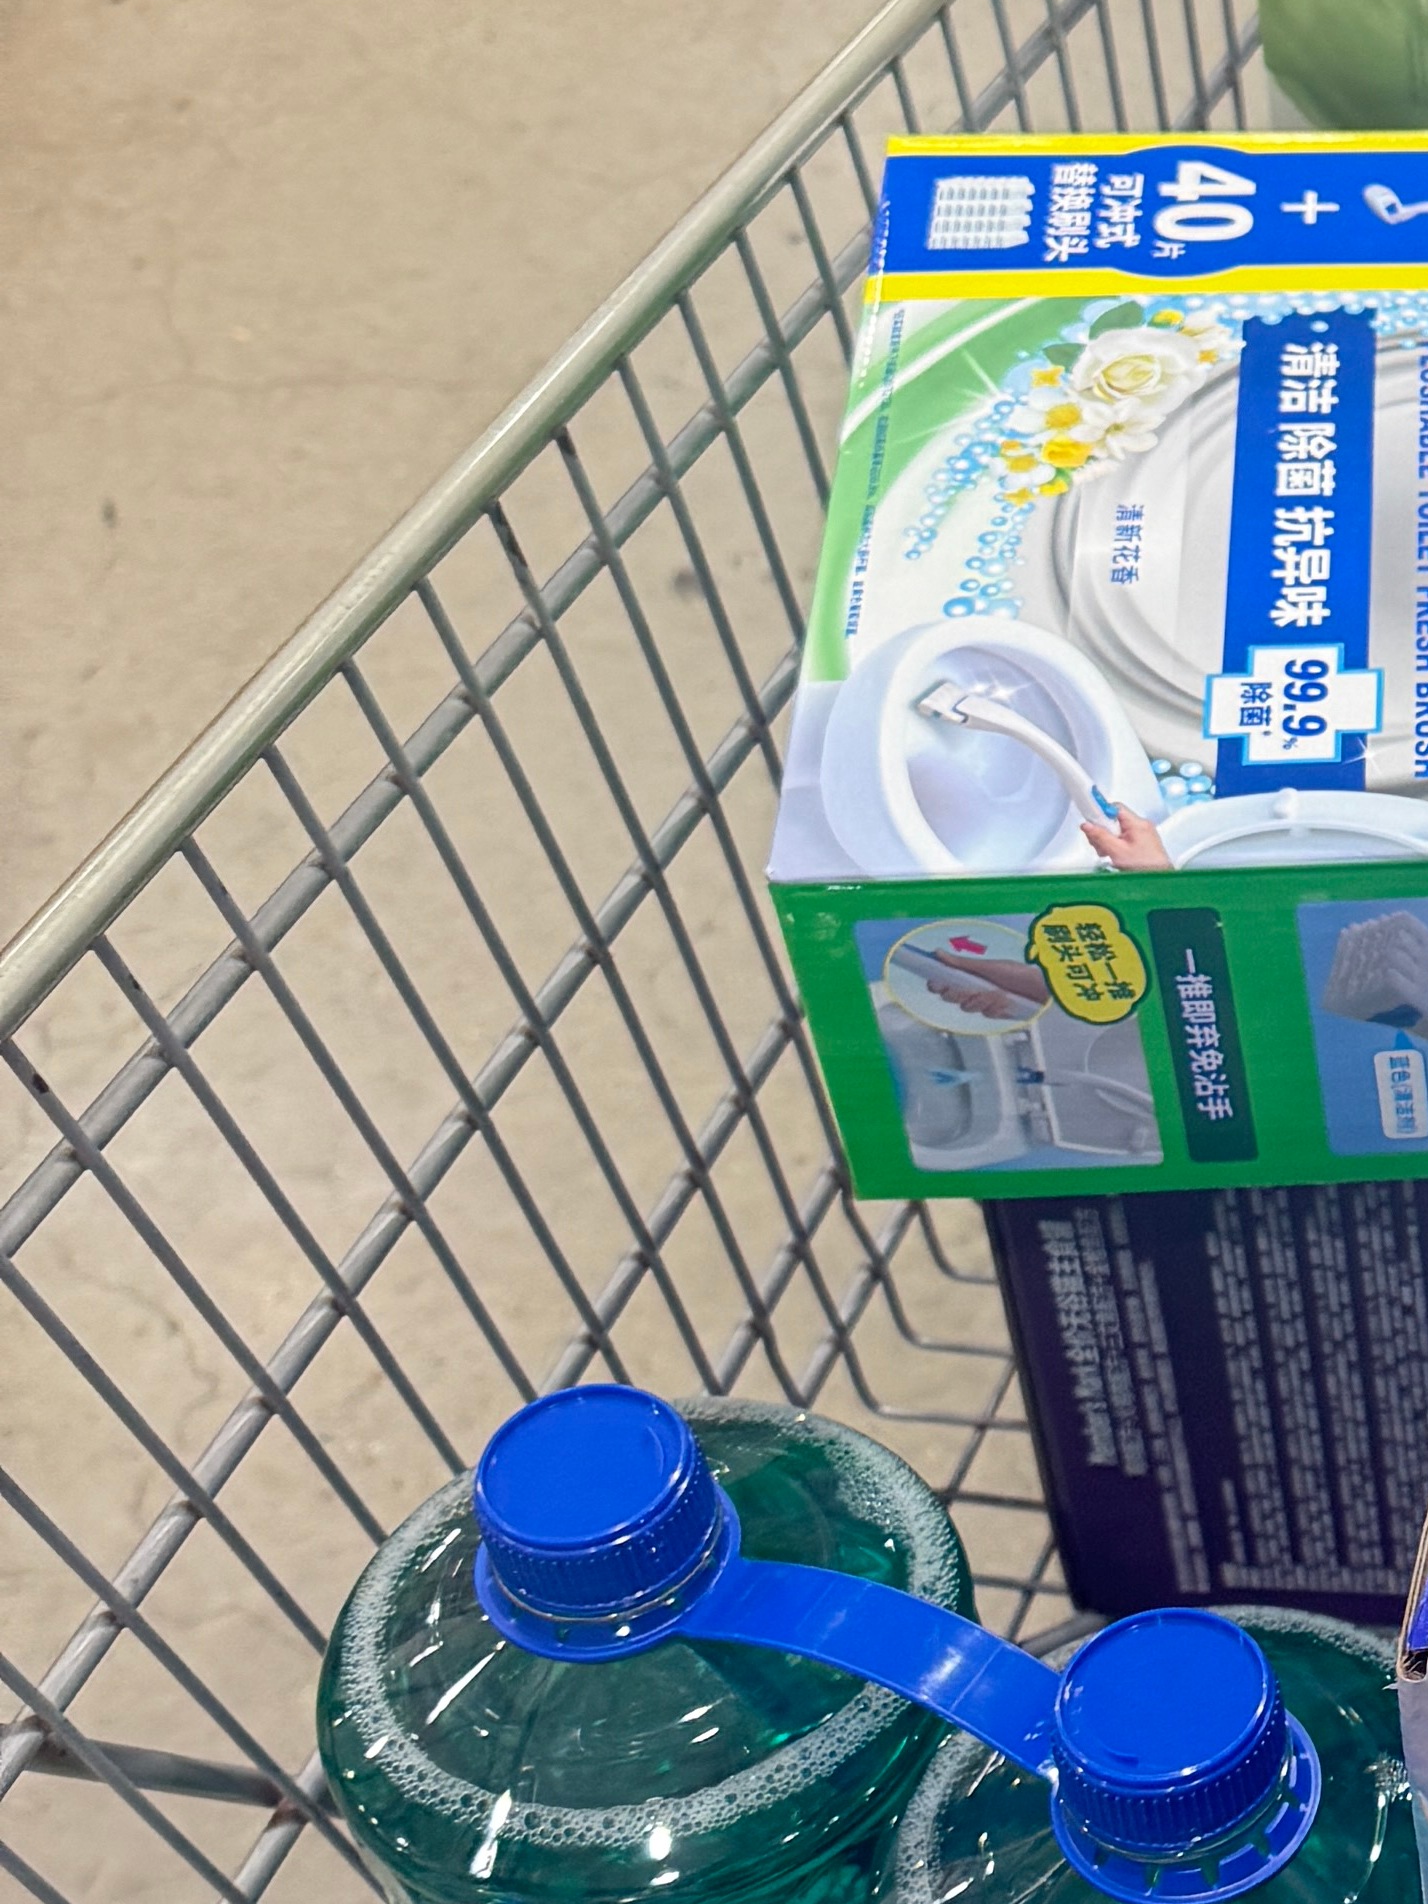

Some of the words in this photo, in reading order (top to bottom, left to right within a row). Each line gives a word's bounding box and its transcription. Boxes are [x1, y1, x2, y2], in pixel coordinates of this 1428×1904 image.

[1044, 162, 1099, 264] 替换刷头
[1095, 172, 1145, 250] 可冲式
[1278, 341, 1340, 415] 清洁
[1275, 421, 1337, 498] 除菌
[1110, 503, 1145, 586] 清新花香
[1269, 505, 1334, 628] 抗异味
[1174, 946, 1236, 1124] 一推即弃免沾手
